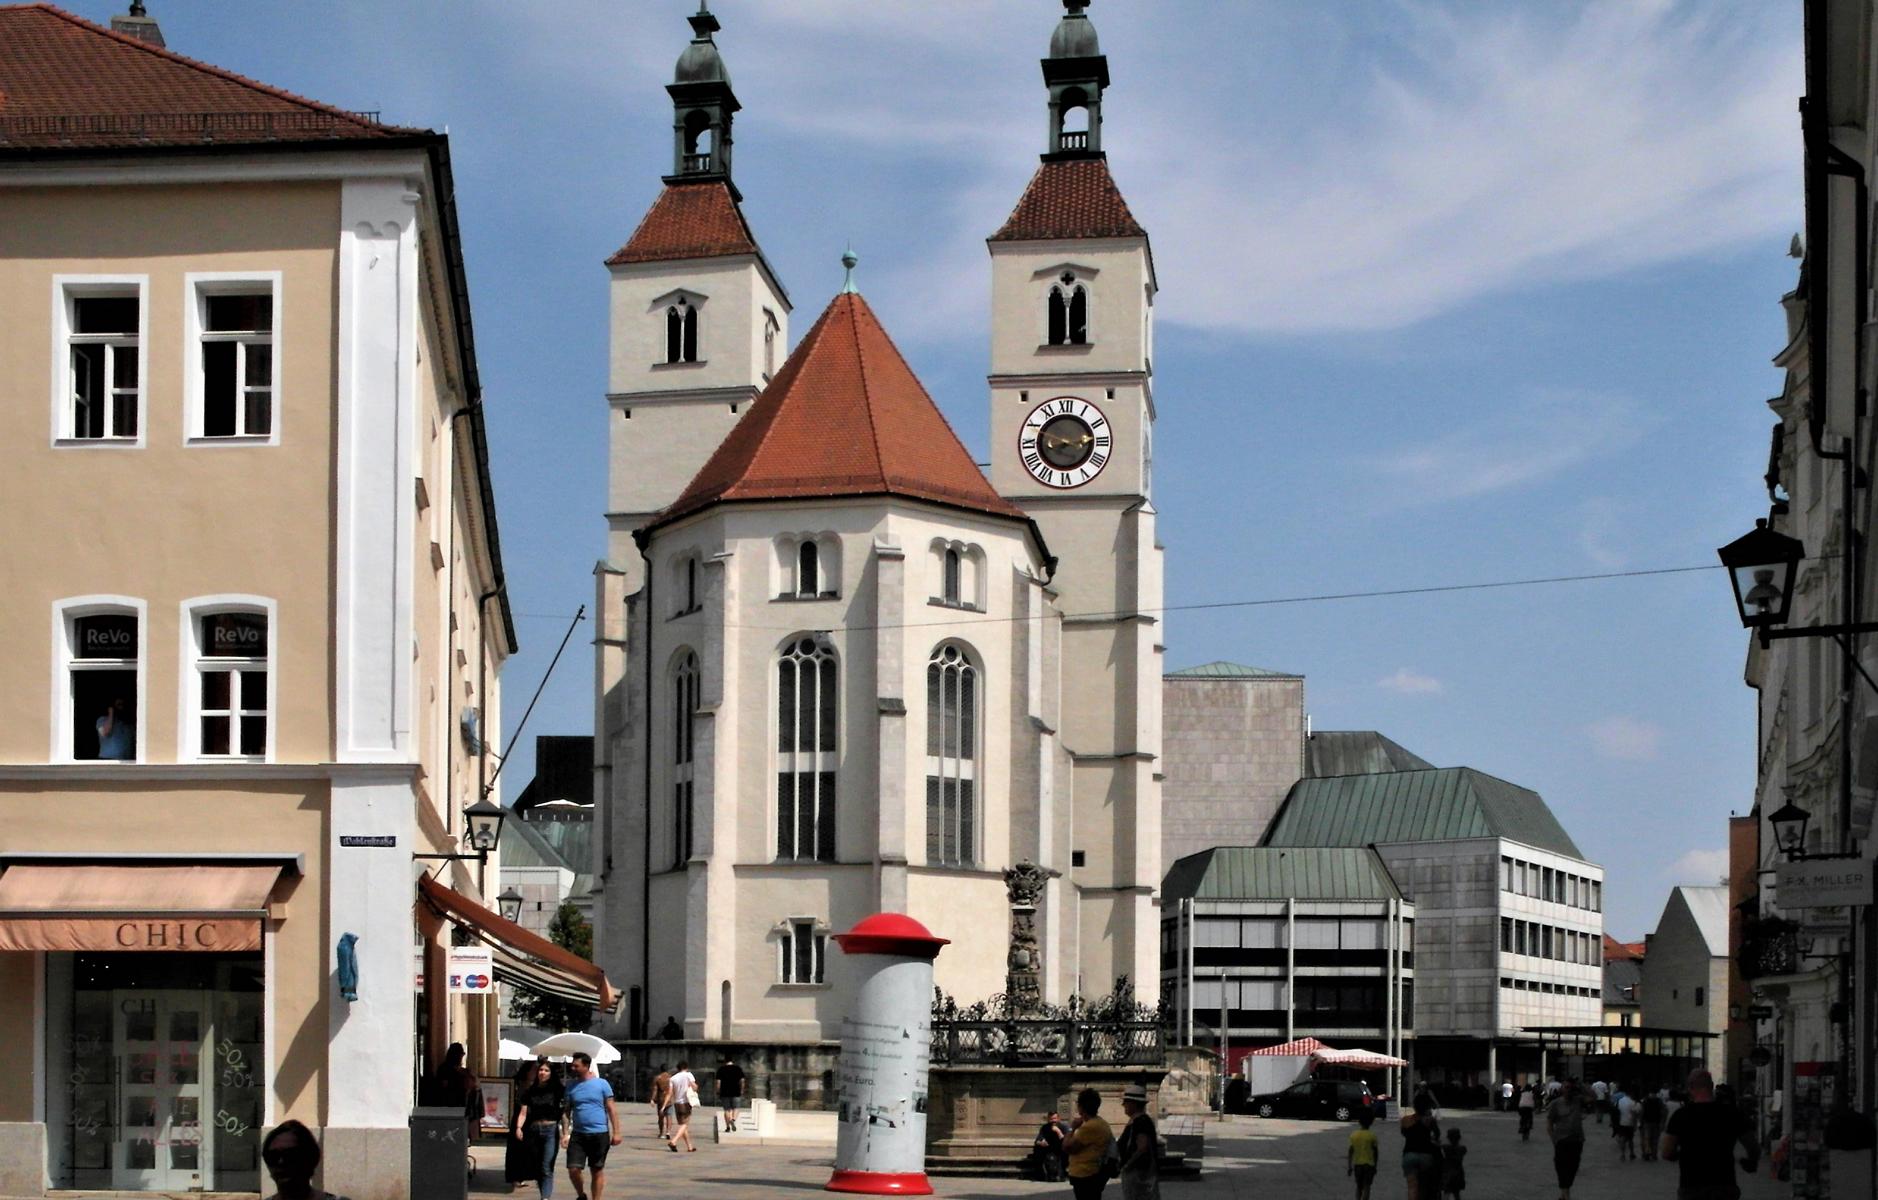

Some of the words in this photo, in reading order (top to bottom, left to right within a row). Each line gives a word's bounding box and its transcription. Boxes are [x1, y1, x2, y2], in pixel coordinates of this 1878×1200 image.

[1040, 404, 1055, 419] XI
[1059, 400, 1074, 413] XII
[1080, 405, 1089, 416] I
[1091, 417, 1105, 429] II
[1023, 438, 1035, 449] IX
[1096, 436, 1109, 447] III
[1025, 452, 1042, 471] VIII
[1089, 452, 1106, 468] IIII
[1038, 466, 1053, 483] VII
[1060, 472, 1072, 486] VI
[1080, 468, 1090, 481] V
[87, 628, 131, 644] ReVo
[214, 626, 259, 643] ReVo
[1814, 874, 1864, 886] MILLER
[116, 923, 217, 947] CHIC
[213, 1109, 249, 1137] 50%
